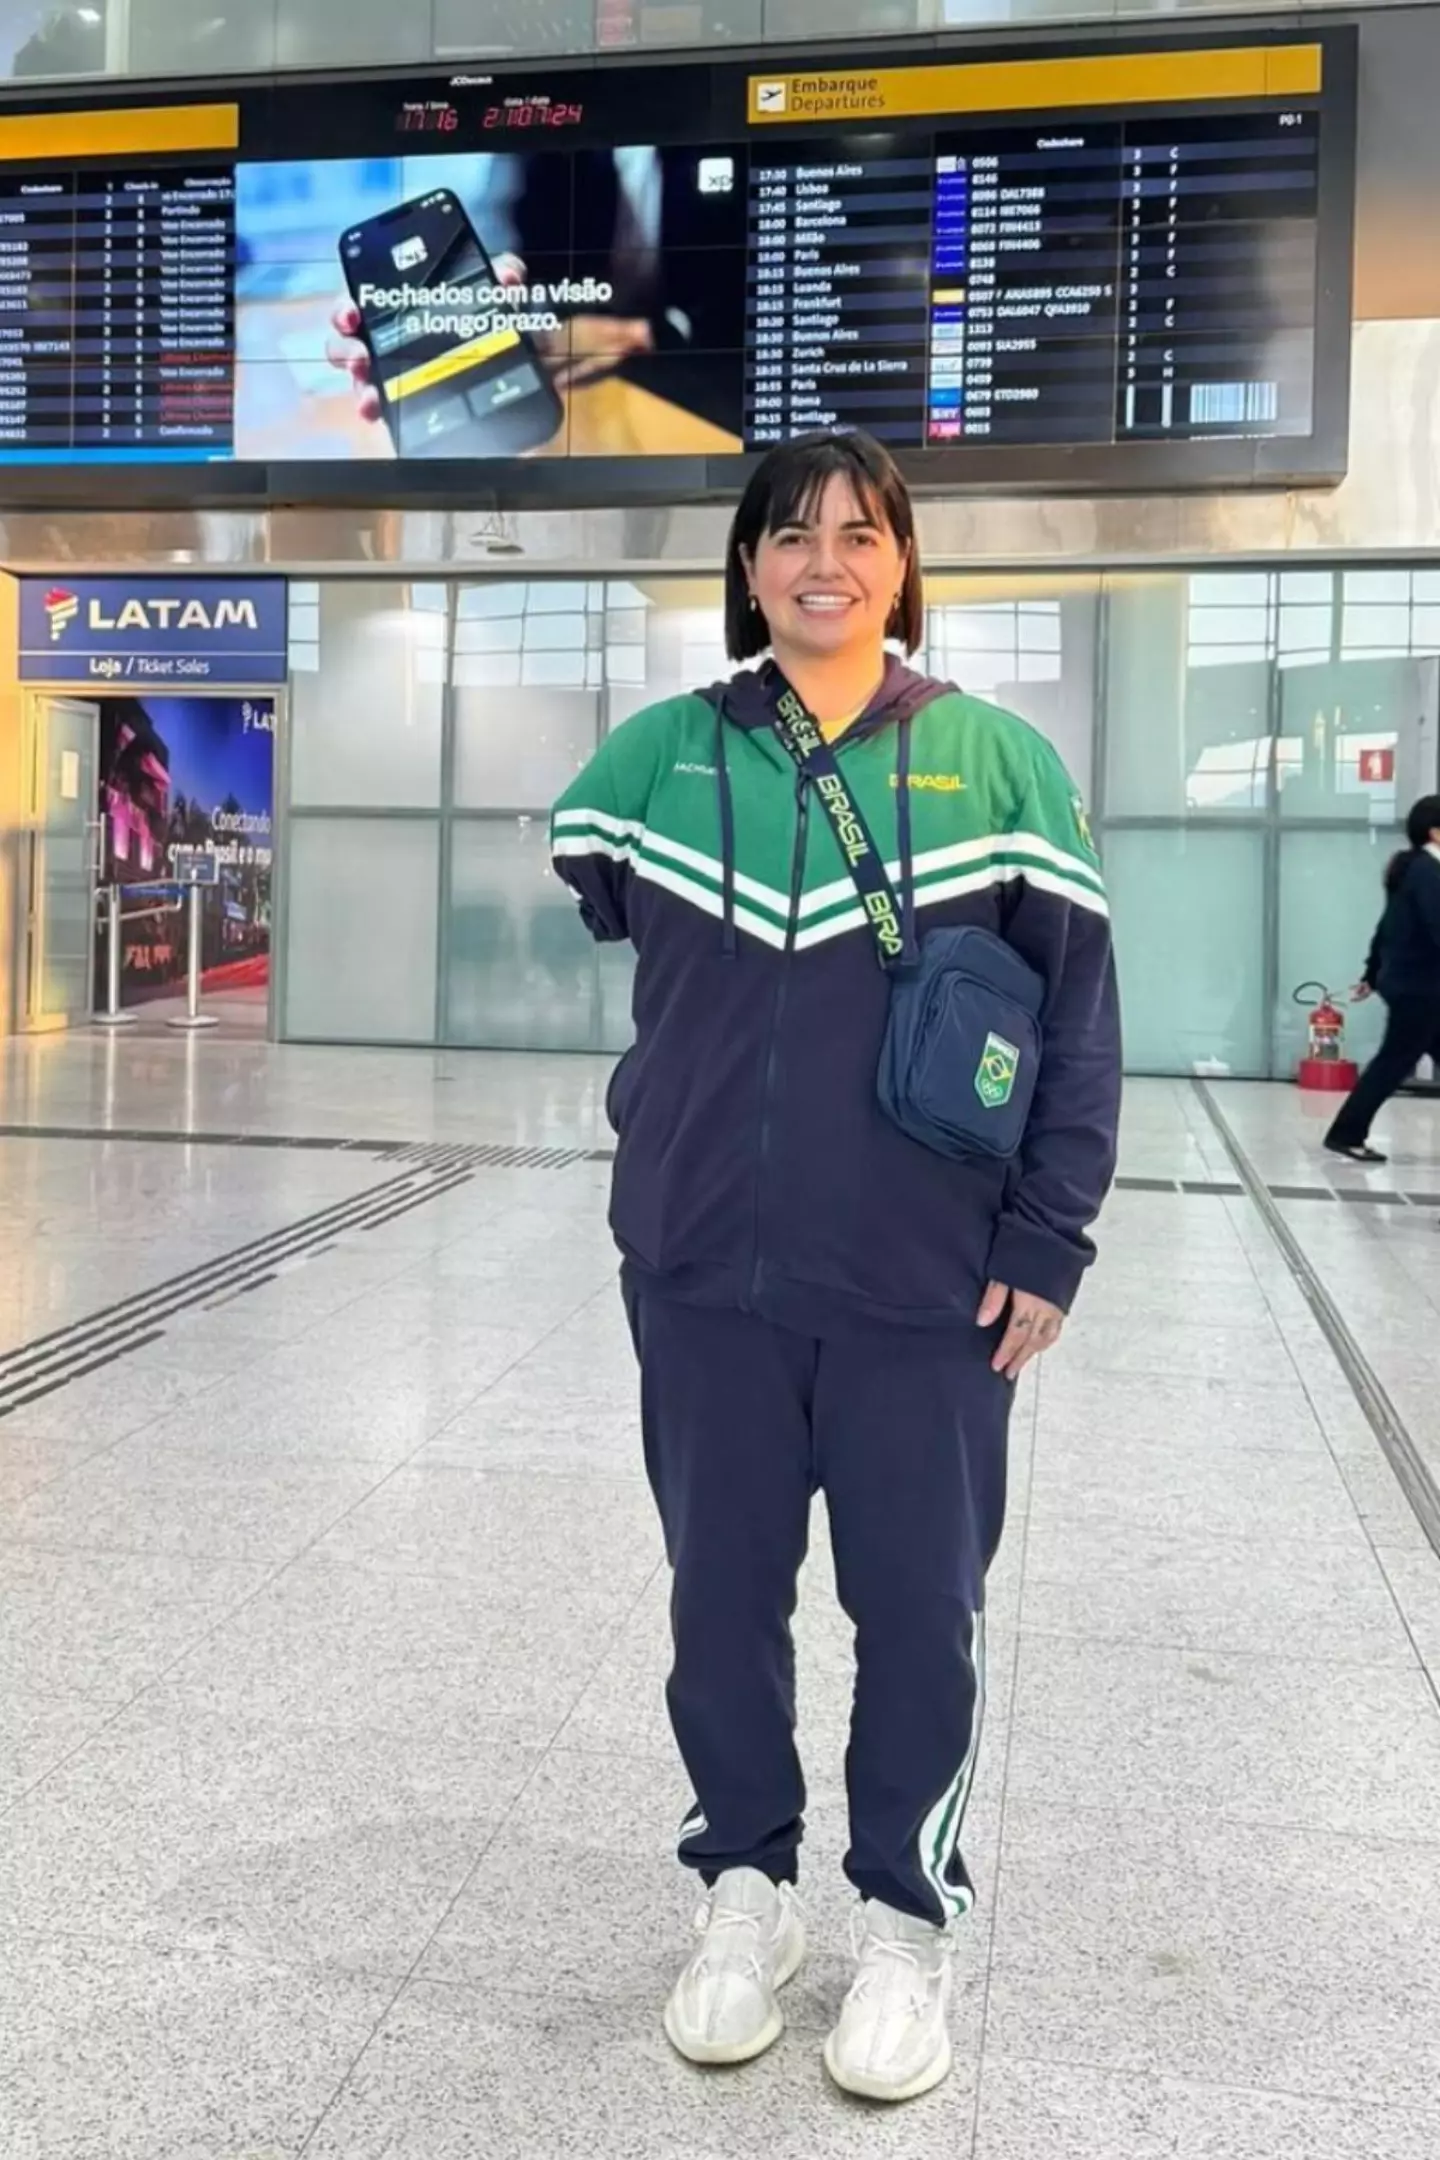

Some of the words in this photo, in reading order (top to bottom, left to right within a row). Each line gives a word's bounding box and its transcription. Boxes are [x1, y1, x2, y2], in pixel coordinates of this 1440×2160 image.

[792, 78, 878, 95] Embarque
[791, 95, 885, 112] Departures
[796, 167, 834, 179] Buenos
[836, 165, 863, 176] Aires
[795, 183, 829, 195] Lisboa
[795, 200, 842, 213] Santiago
[795, 215, 847, 228] Barcelona
[834, 264, 860, 275] Aires
[359, 283, 472, 307] Fechados
[477, 287, 527, 304] com
[532, 287, 545, 303] a
[550, 277, 612, 302] visão
[793, 281, 831, 293] Luanda
[793, 297, 842, 309] Frankfurt
[407, 315, 421, 332] a
[425, 311, 489, 337] longo
[492, 310, 562, 338] prazo.
[792, 314, 839, 327] Santiago
[832, 329, 859, 340] Aires
[792, 363, 821, 374] Santa
[823, 362, 847, 373] Cruz
[848, 361, 861, 372] de
[864, 361, 875, 372] La
[877, 361, 908, 371] Sierra
[790, 396, 821, 406] Roma
[790, 411, 836, 424] Santiago
[89, 599, 258, 629] LATAM
[89, 658, 122, 678] Loja
[124, 656, 135, 676] /
[137, 659, 173, 674] Ticket
[176, 658, 210, 675] Sales
[212, 806, 271, 833] Conectando
[816, 774, 870, 868] BRASIL
